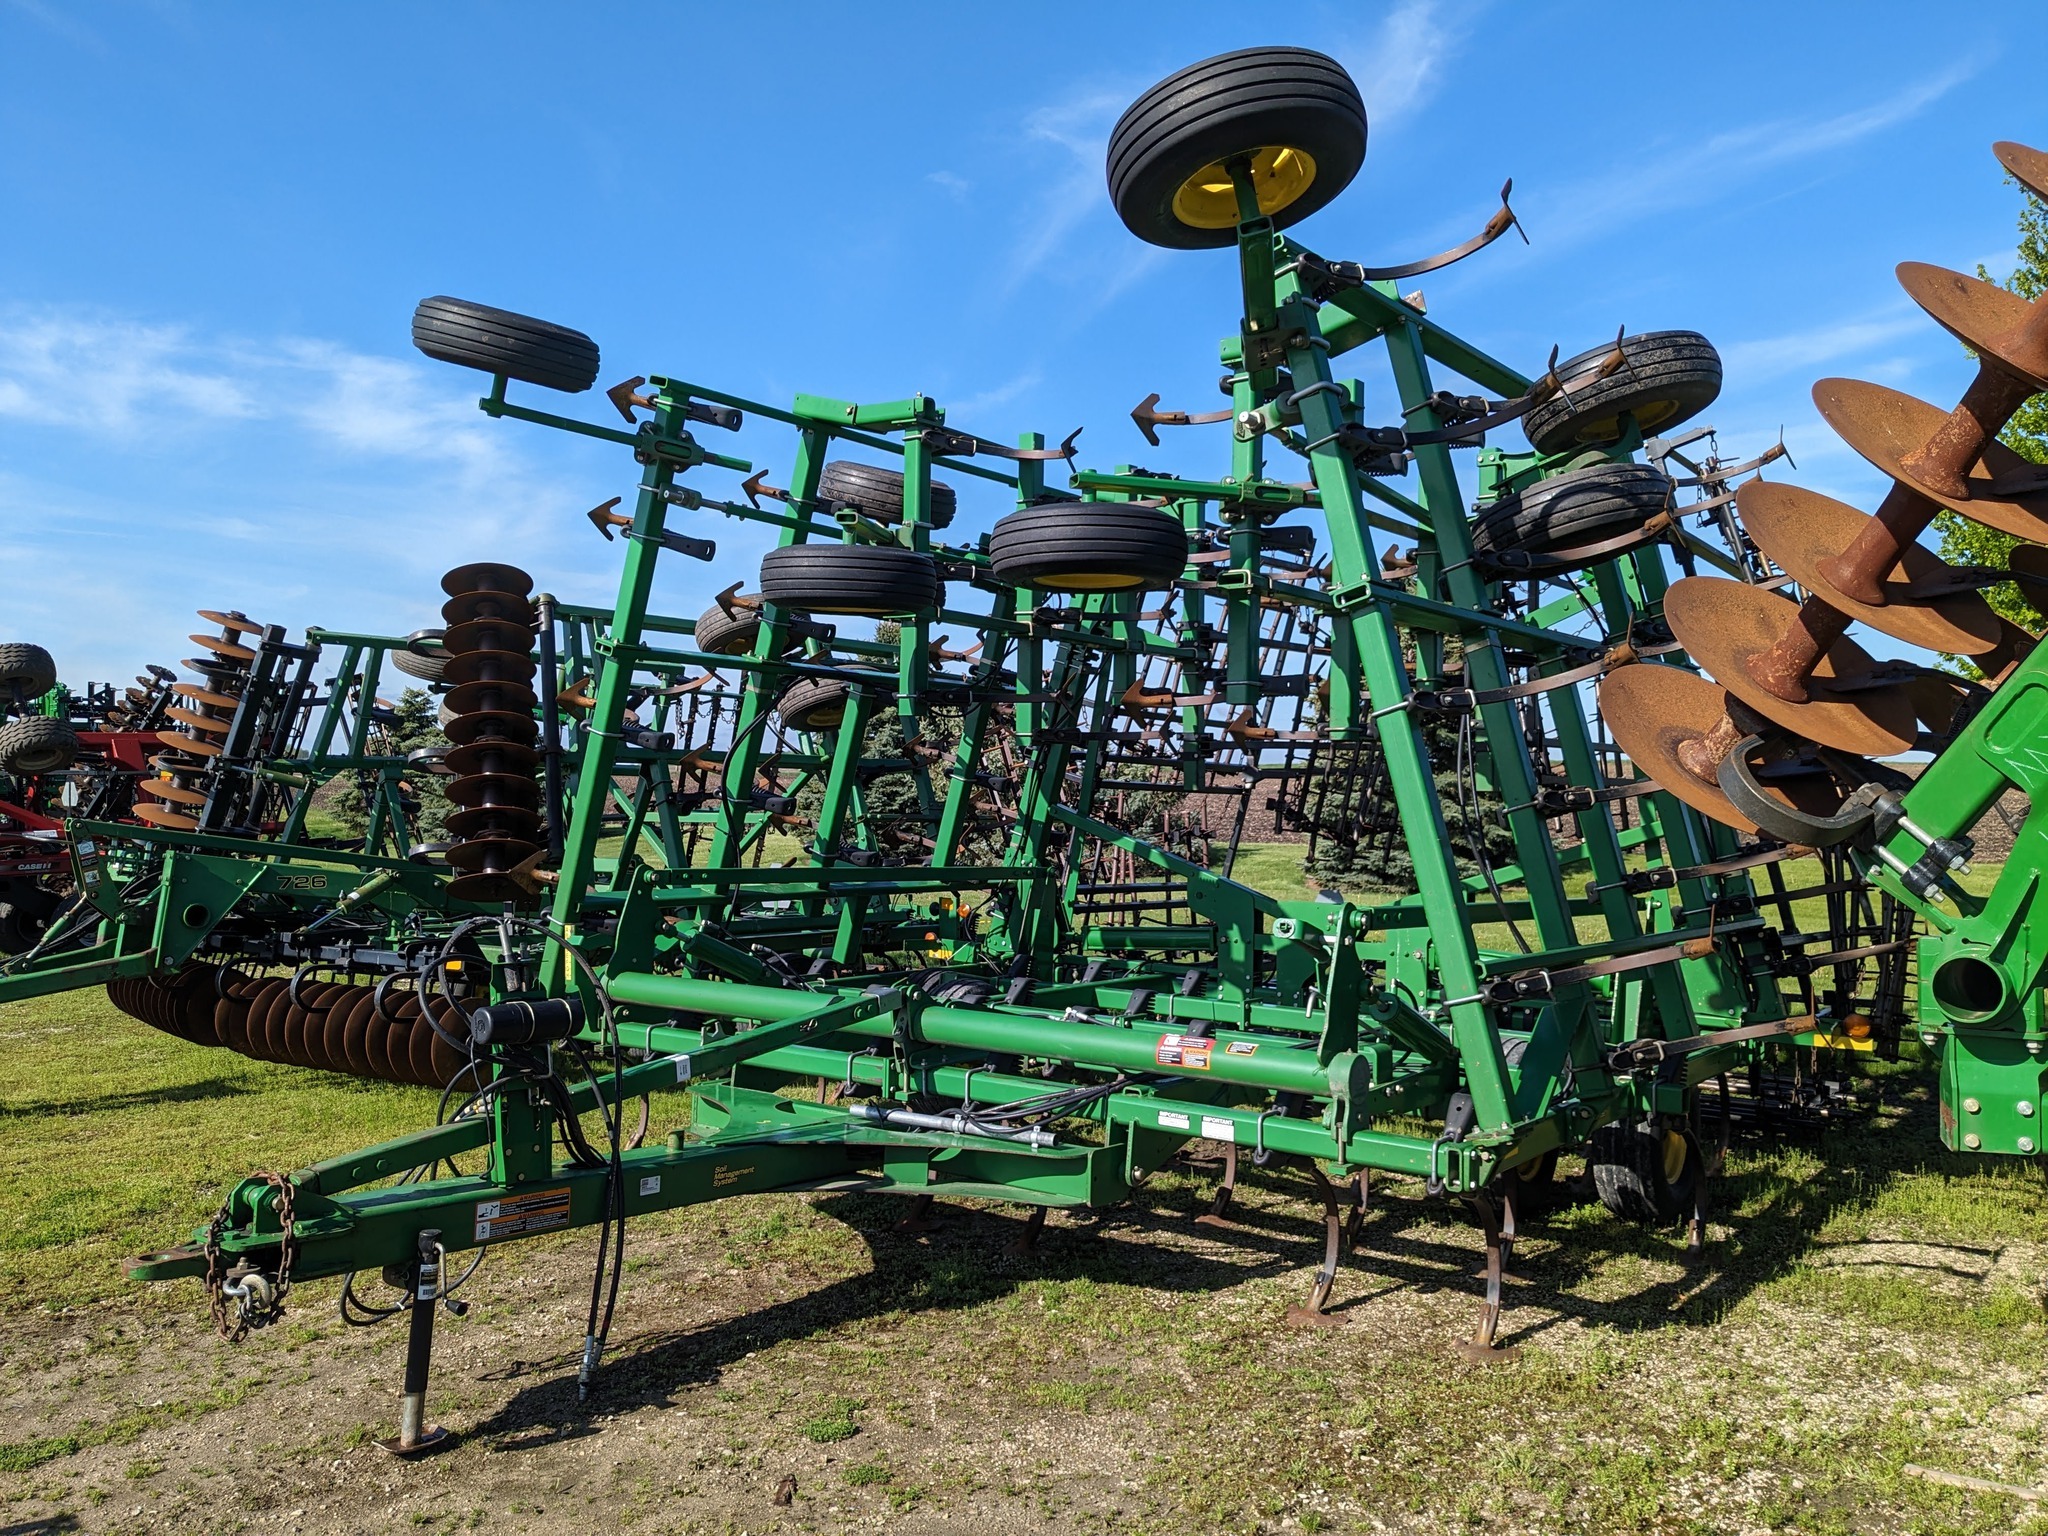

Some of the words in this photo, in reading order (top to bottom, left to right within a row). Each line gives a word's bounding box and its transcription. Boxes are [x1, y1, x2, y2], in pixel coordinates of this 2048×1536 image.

[277, 875, 327, 890] 726
[1159, 1110, 1189, 1120] IMPORTANT
[1202, 1115, 1233, 1126] IMPORTANT
[713, 1166, 755, 1180] Management
[715, 1165, 728, 1173] Soil
[712, 1177, 738, 1187] System
